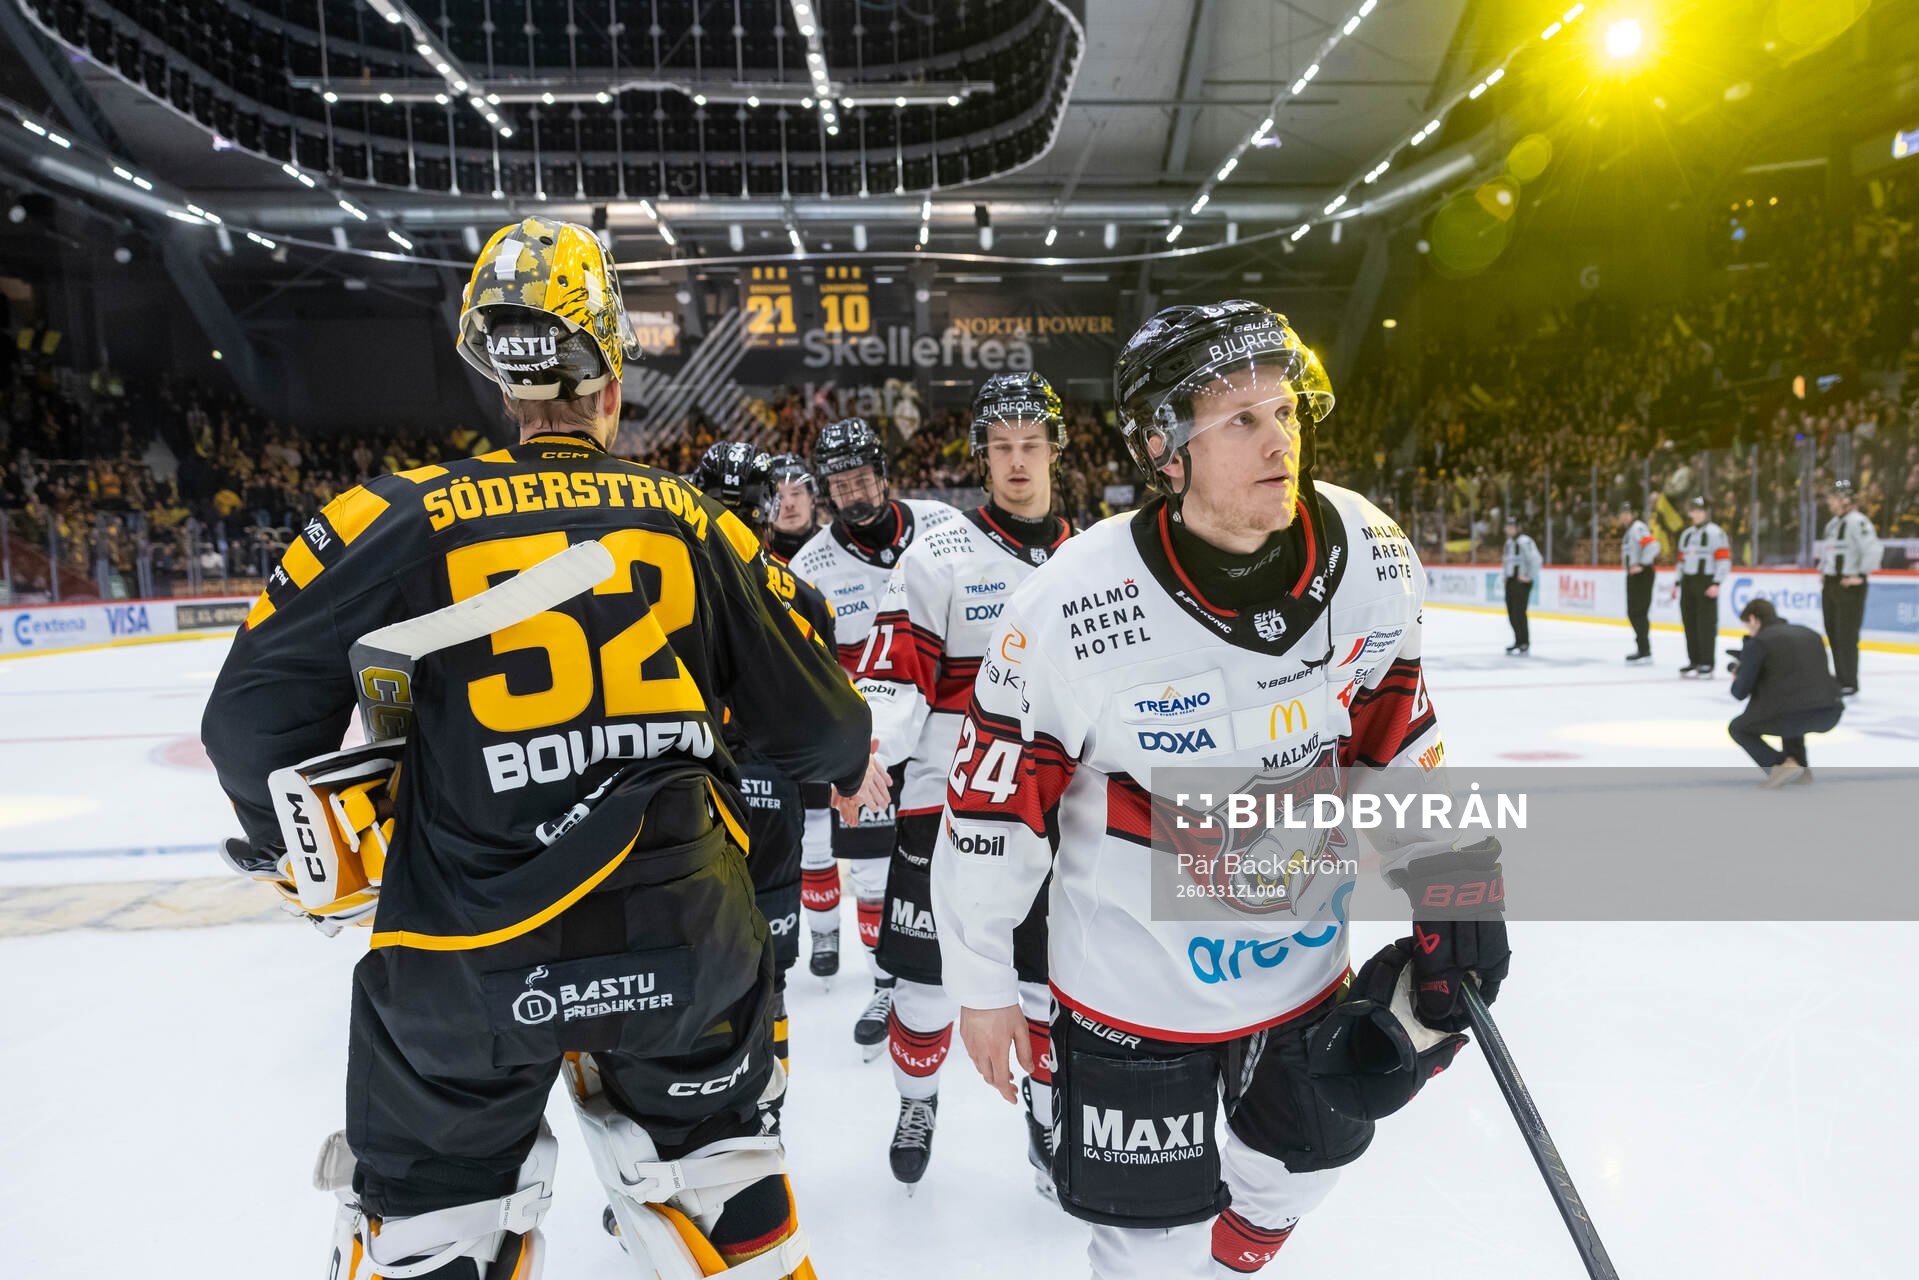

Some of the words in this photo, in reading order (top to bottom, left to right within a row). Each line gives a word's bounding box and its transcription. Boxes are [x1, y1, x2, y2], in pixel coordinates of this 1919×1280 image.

[747, 295, 797, 333] 21
[821, 294, 870, 332] 10
[955, 318, 1031, 336] NORTH
[1038, 315, 1115, 334] POWER
[804, 326, 1034, 370] Skellefteå
[1208, 331, 1289, 363] BJURFO
[803, 378, 908, 420] Kraf
[982, 401, 1040, 417] BJURFORS
[541, 451, 590, 459] CCM
[423, 471, 709, 541] SÖDERSTRÖM
[929, 536, 972, 549] ARENA
[933, 545, 975, 558] HOTEL
[1376, 564, 1411, 581] HOTE
[1558, 575, 1596, 600] MAXI
[964, 582, 1006, 594] TREANO
[1062, 578, 1140, 618] MALMÖ
[1753, 586, 1823, 610] exten
[106, 605, 151, 635] VISA
[837, 601, 869, 617] DOXA
[1070, 605, 1146, 639] ARENA
[33, 616, 86, 633] extena
[446, 528, 707, 733] 52
[1254, 617, 1287, 641] 50
[1074, 626, 1151, 660] HOTEL
[1134, 692, 1211, 713] TREANO
[1138, 728, 1217, 754] DOXA
[1261, 731, 1320, 772] MALMÖ
[948, 716, 1023, 803] 24
[740, 778, 772, 796] STU
[286, 792, 326, 882] CCM
[1422, 875, 1505, 907] BAU
[892, 897, 937, 932] MA
[560, 972, 655, 1006] BASTU
[563, 993, 674, 1022] PRODUKTER
[892, 1041, 949, 1068] SÄKRA
[667, 1052, 750, 1097] CCM
[1083, 1104, 1204, 1152] MAXI
[1083, 1146, 1100, 1161] ICA
[1103, 1145, 1204, 1165] STORMARKNAD
